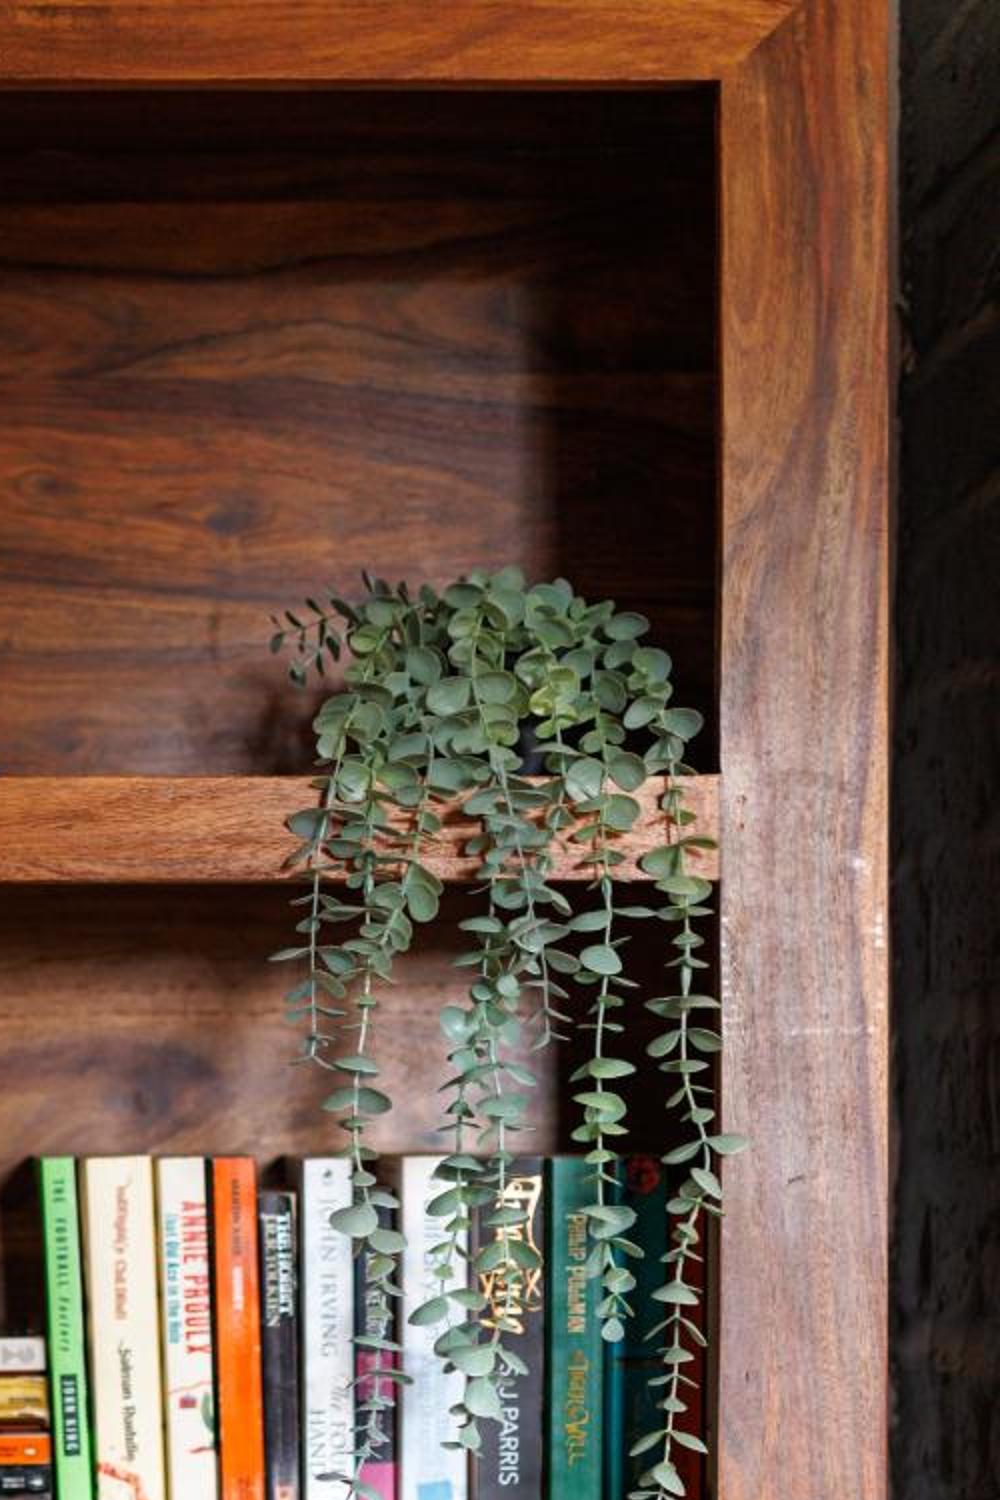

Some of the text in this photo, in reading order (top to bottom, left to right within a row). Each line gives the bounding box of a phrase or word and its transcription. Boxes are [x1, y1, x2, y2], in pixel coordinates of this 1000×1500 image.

[53, 1179, 66, 1203] THE
[55, 1217, 69, 1287] FOOTBALL
[182, 1200, 212, 1355] ANNIE PROULX
[319, 1273, 341, 1358] IRVING
[61, 1379, 79, 1452] JOHN KING
